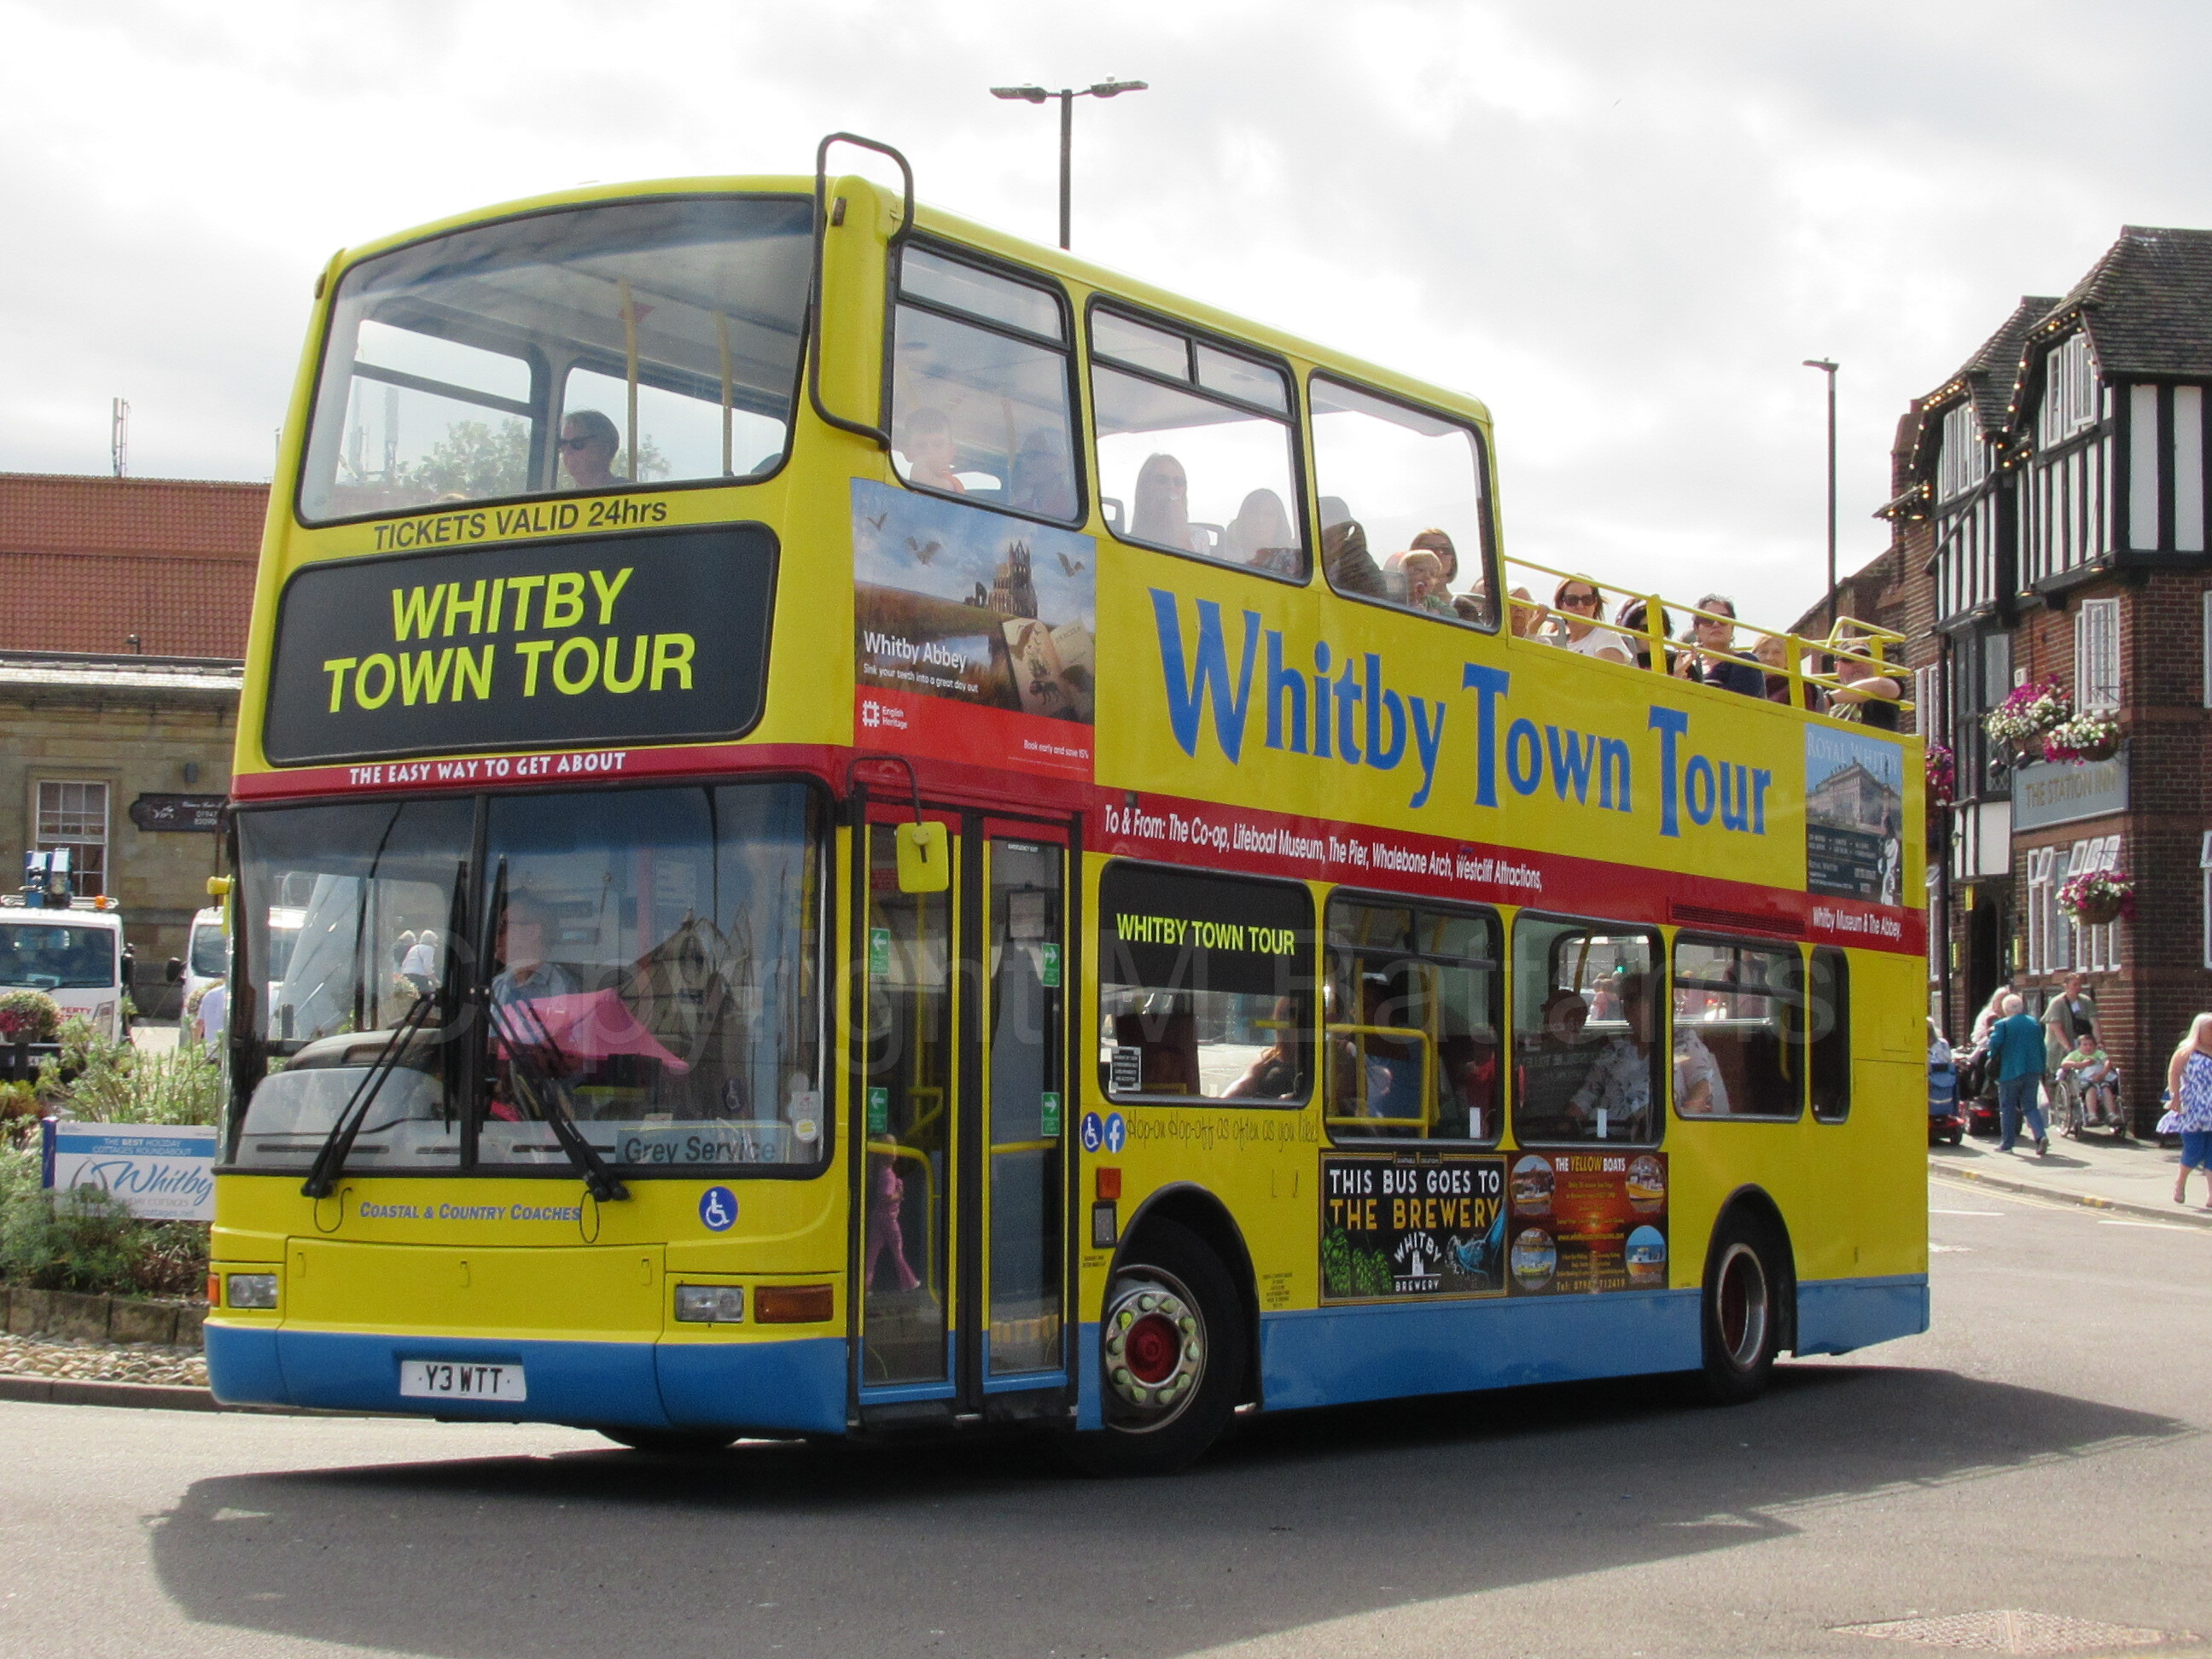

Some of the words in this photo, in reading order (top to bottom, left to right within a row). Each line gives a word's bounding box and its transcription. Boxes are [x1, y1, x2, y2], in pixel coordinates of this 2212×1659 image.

[374, 513, 486, 550] TICKETS
[496, 504, 579, 536] VALID
[588, 498, 667, 528] 24hrs
[392, 568, 634, 642] WHITBY
[863, 630, 920, 666] Whitby
[923, 642, 967, 674] Abbey
[323, 643, 494, 713] TOWN
[515, 632, 696, 697] TOUR
[864, 663, 877, 675] Sink
[879, 668, 896, 678] your
[897, 670, 915, 681] teeth
[917, 672, 928, 683] into
[936, 678, 953, 689] great
[954, 680, 966, 692] day
[967, 684, 979, 693] out
[882, 707, 905, 719] English
[882, 717, 909, 731] Heritage
[1147, 586, 1446, 810] Whitby
[1462, 661, 1632, 813] Town
[1648, 705, 1772, 838] Tour
[350, 766, 381, 785] THE
[387, 764, 430, 783] EASY
[437, 760, 478, 780] WAY
[485, 759, 509, 777] TO
[516, 756, 551, 775] GET
[556, 752, 626, 773] ABOUT
[2025, 781, 2046, 808] THE
[1105, 805, 1119, 834] To
[1121, 807, 1131, 835] &
[1133, 808, 1166, 840] From:
[1169, 813, 1189, 842] The
[1191, 817, 1230, 853] Co-op,
[1232, 823, 1278, 854] Lifeboat
[1278, 829, 1326, 864] Museum,
[1329, 835, 1347, 864] The
[1348, 839, 1370, 870] Pier,
[1372, 842, 1427, 874] Whalebone
[1429, 851, 1453, 882] Arch,
[1456, 854, 1493, 883] Westcliff
[1493, 860, 1542, 893] Attractions,
[1116, 913, 1189, 946] WHITBY
[1190, 921, 1243, 951] TOWN
[1248, 926, 1295, 956] TOUR
[1813, 906, 1835, 933] Whitby
[1836, 909, 1862, 932] Museum
[1863, 913, 1868, 933] &
[1869, 913, 1879, 934] The
[103, 1138, 120, 1146] THE
[625, 1138, 678, 1163] Grey
[685, 1136, 777, 1162] Service
[1216, 1117, 1229, 1139] as
[1262, 1120, 1275, 1142] as
[1279, 1121, 1295, 1152] you
[92, 1146, 135, 1155] COTTAGES
[136, 1147, 192, 1156] ROUNDABOUT
[1555, 1157, 1569, 1172] THE
[1570, 1155, 1604, 1173] YELLOW
[1603, 1157, 1626, 1172] BOATS
[90, 1161, 213, 1206] Whitby
[1329, 1168, 1373, 1194] THIS
[1382, 1169, 1417, 1194] BUS
[1426, 1169, 1471, 1194] GOES
[1477, 1169, 1500, 1193] TO
[360, 1202, 420, 1219] COASTAL
[424, 1205, 434, 1220] &
[439, 1202, 506, 1220] COUNTRY
[510, 1203, 581, 1221] COACHES
[1329, 1198, 1377, 1230] THE
[1393, 1196, 1500, 1230] BREWERY
[1394, 1231, 1442, 1263] WHITBY
[1394, 1279, 1440, 1293] BREWERY
[425, 1365, 453, 1391] Y3
[460, 1367, 503, 1393] WTT
